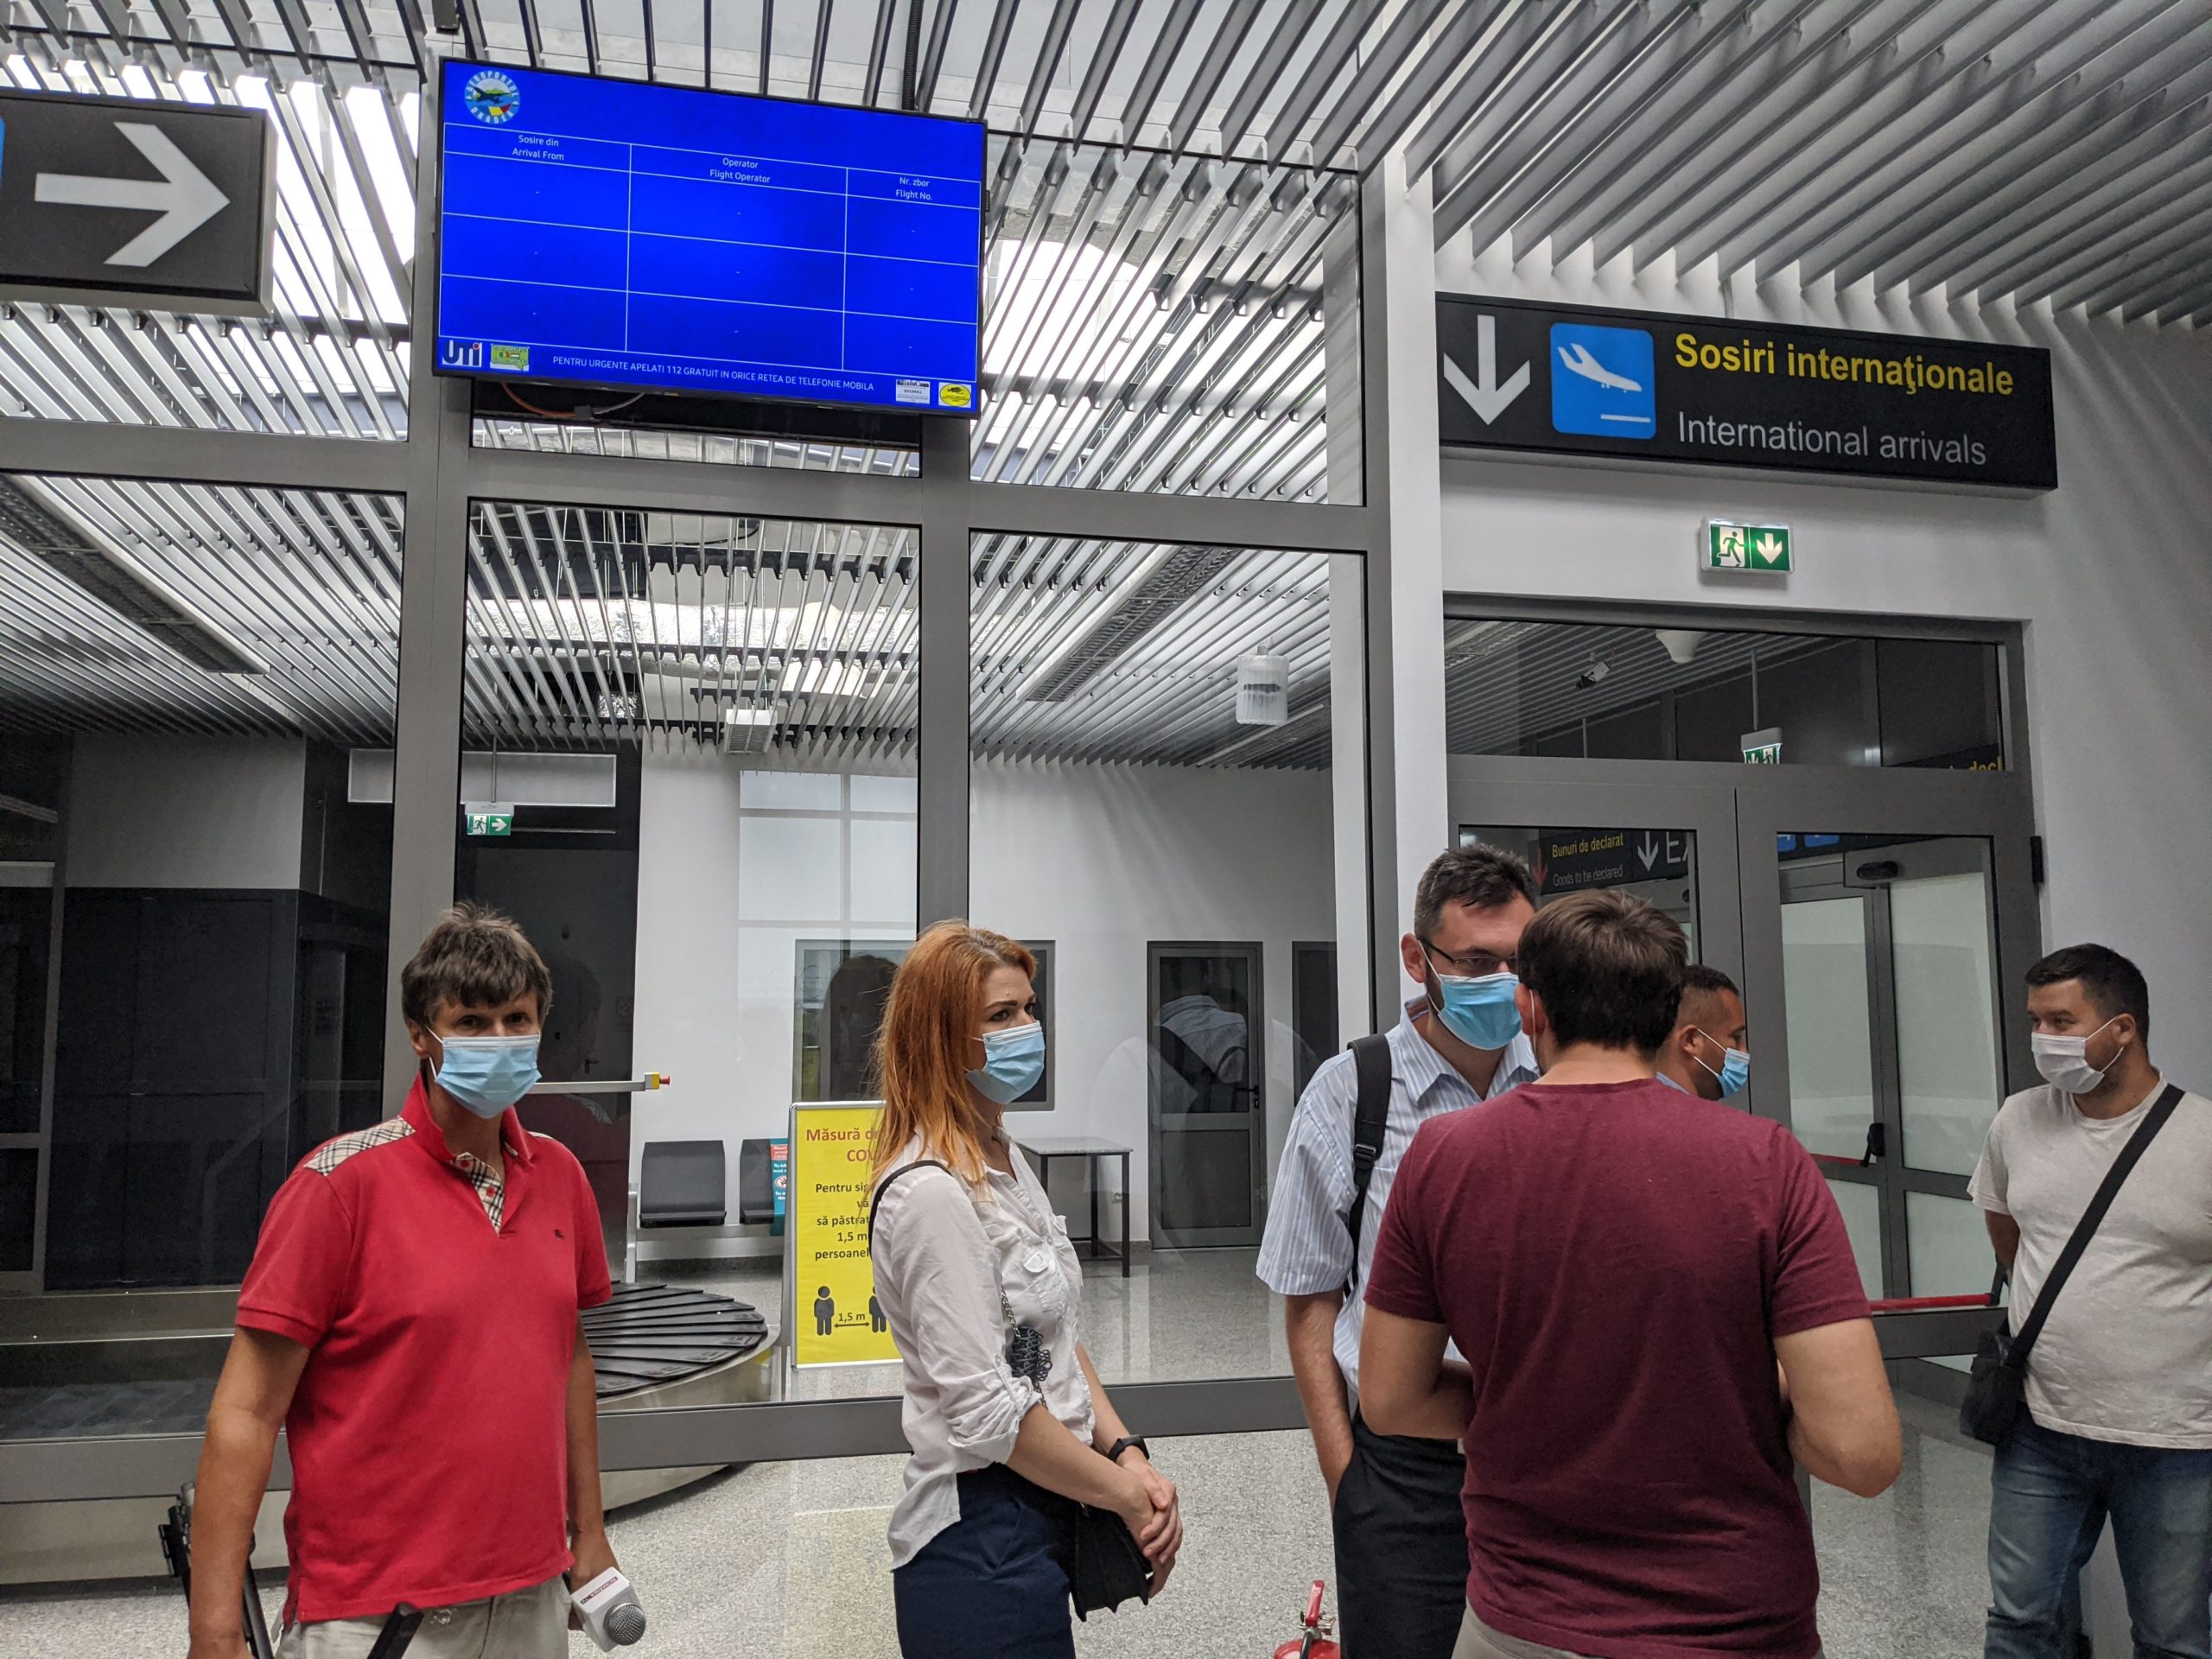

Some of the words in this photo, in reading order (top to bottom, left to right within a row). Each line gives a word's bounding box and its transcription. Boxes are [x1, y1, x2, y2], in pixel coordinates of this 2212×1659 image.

[518, 135, 544, 145] Sosire
[546, 138, 559, 147] din
[512, 148, 541, 158] Arrival
[543, 151, 564, 161] From
[722, 157, 759, 168] Operator
[709, 168, 734, 180] Flight
[735, 172, 771, 183] Operator
[899, 176, 912, 185] Nr.
[912, 178, 930, 187] zbor
[895, 188, 918, 200] Flight
[919, 192, 932, 200] No.
[1675, 333, 1776, 374] Sosiri
[553, 356, 588, 367] PENTRU
[588, 359, 628, 371] URGENTE
[630, 363, 664, 373] APELATI
[667, 365, 682, 375] 112
[683, 367, 719, 378] GRATUIT
[721, 370, 729, 378] IN
[731, 371, 756, 381] ORICE
[758, 373, 784, 383] RETEA
[785, 376, 797, 385] DE
[798, 377, 842, 388] TELEFONIE
[843, 381, 874, 391] MOBILA
[1678, 410, 1869, 457] International
[1879, 430, 1986, 466] arrivals
[1552, 841, 1578, 858] Bunuri
[1579, 838, 1589, 853] de
[1591, 832, 1624, 851] declarat
[1553, 872, 1573, 887] Goods
[1574, 870, 1582, 883] to
[1583, 869, 1592, 882] be
[1593, 864, 1624, 880] declared
[806, 1127, 861, 1141] Măsură
[816, 1183, 852, 1193] Pentru
[817, 1215, 829, 1226] să
[837, 1231, 854, 1243] 1,5
[857, 1232, 868, 1241] m
[838, 1312, 853, 1322] 1,5
